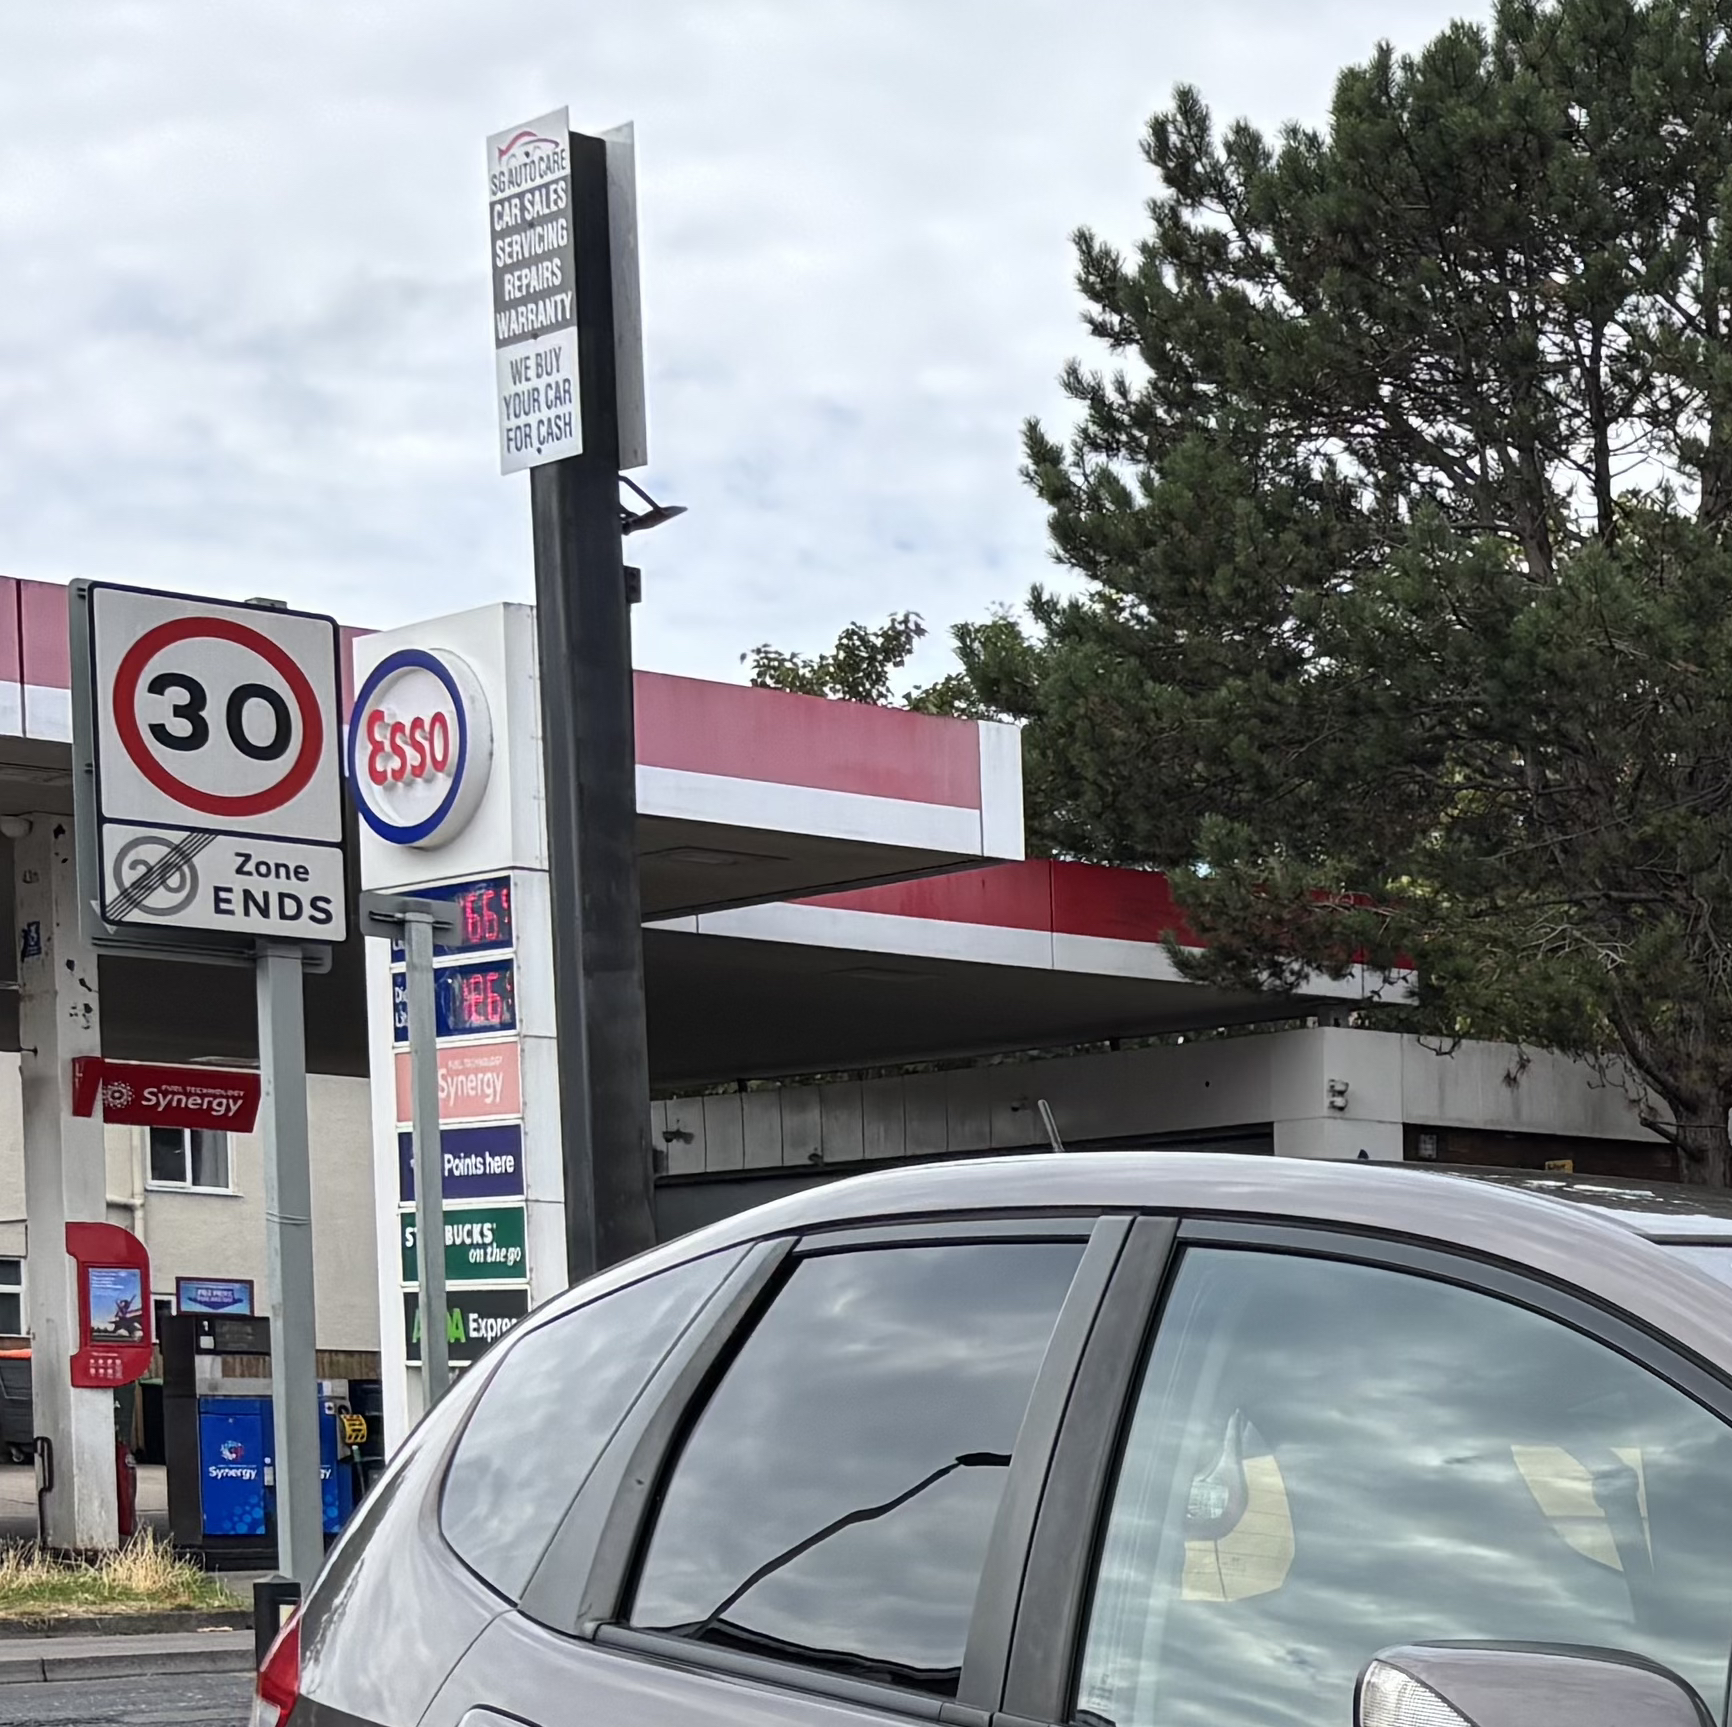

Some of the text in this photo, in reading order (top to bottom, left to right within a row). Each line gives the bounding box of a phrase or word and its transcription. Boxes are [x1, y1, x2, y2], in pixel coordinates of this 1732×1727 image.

[490, 148, 567, 197] SG AUTO CARE
[493, 180, 567, 231] CAR SALES
[495, 217, 568, 268] SERVICING
[503, 257, 562, 301] REPAIRS
[496, 290, 572, 340] WARRANTY
[510, 346, 562, 386] WE BUY
[503, 378, 572, 421] YOUR CAR
[506, 411, 573, 454] FOR CASH
[146, 671, 293, 762] 30
[365, 708, 450, 787] Esso
[234, 851, 310, 883] Zone
[212, 884, 334, 926] ENDS
[141, 1087, 243, 1117] Synergy
[438, 1067, 503, 1107] Synergy
[444, 1153, 484, 1177] Points
[485, 1151, 515, 1175] here
[469, 1245, 522, 1267] on the go
[208, 1465, 257, 1480] Synergy
